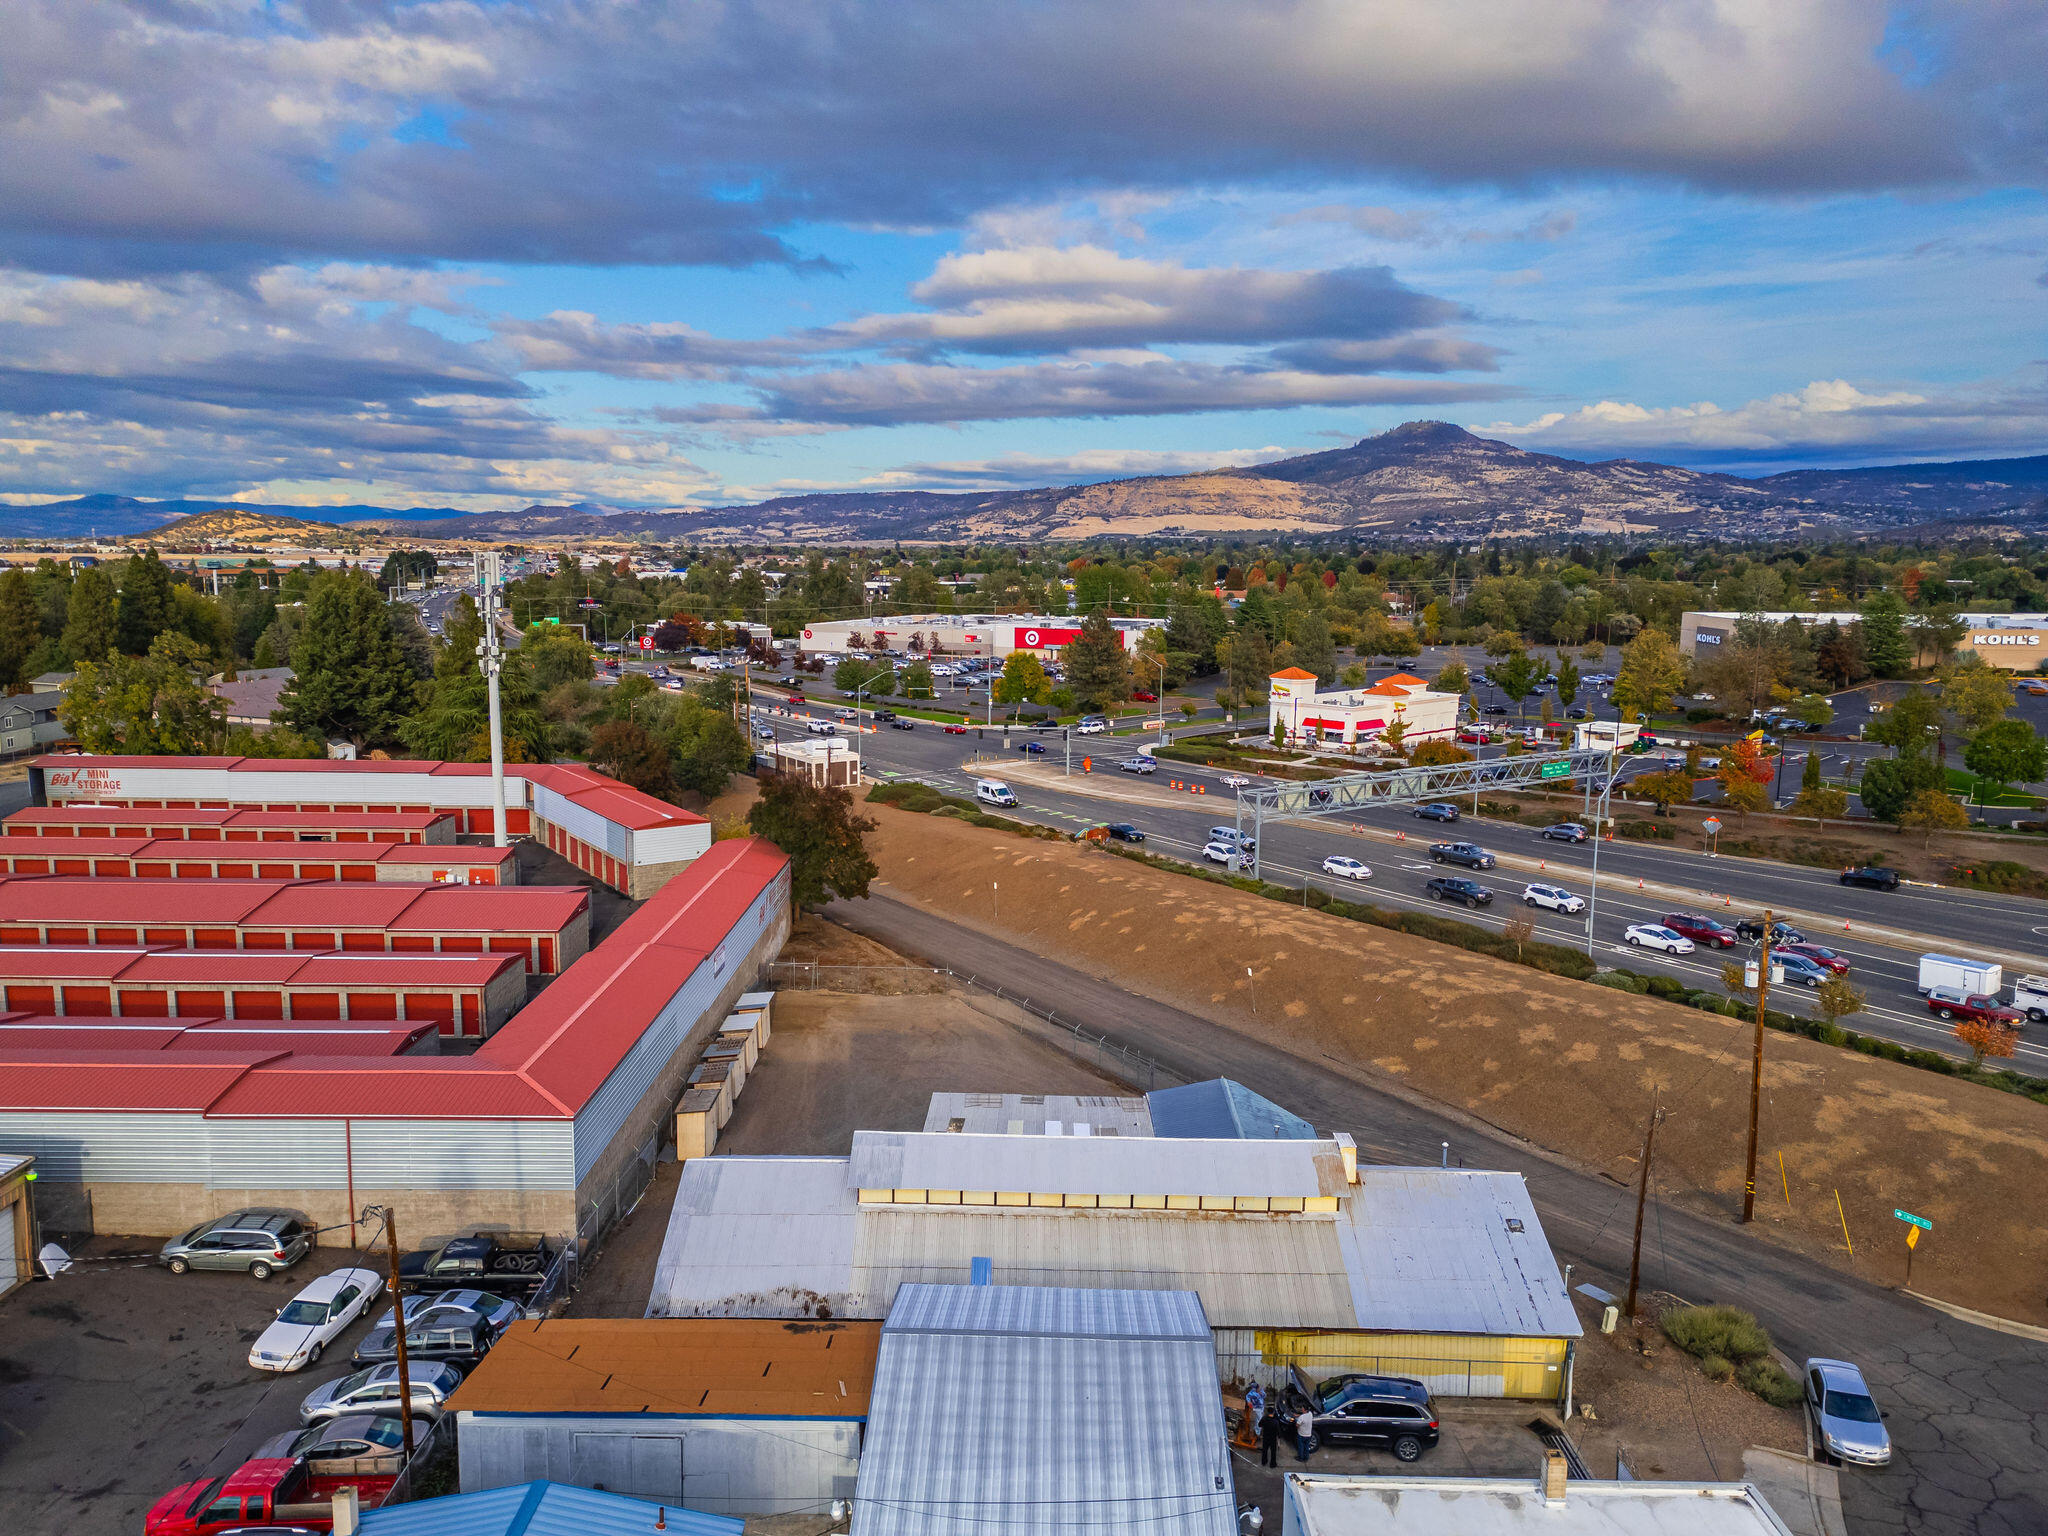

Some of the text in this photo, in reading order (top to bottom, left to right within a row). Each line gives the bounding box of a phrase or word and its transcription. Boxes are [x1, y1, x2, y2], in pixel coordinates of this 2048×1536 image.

[1696, 633, 1720, 644] KOHL'S
[1973, 634, 2040, 646] KOHL'S
[87, 769, 109, 778] MINI
[51, 773, 70, 786] Big
[77, 780, 121, 790] STORAGE
